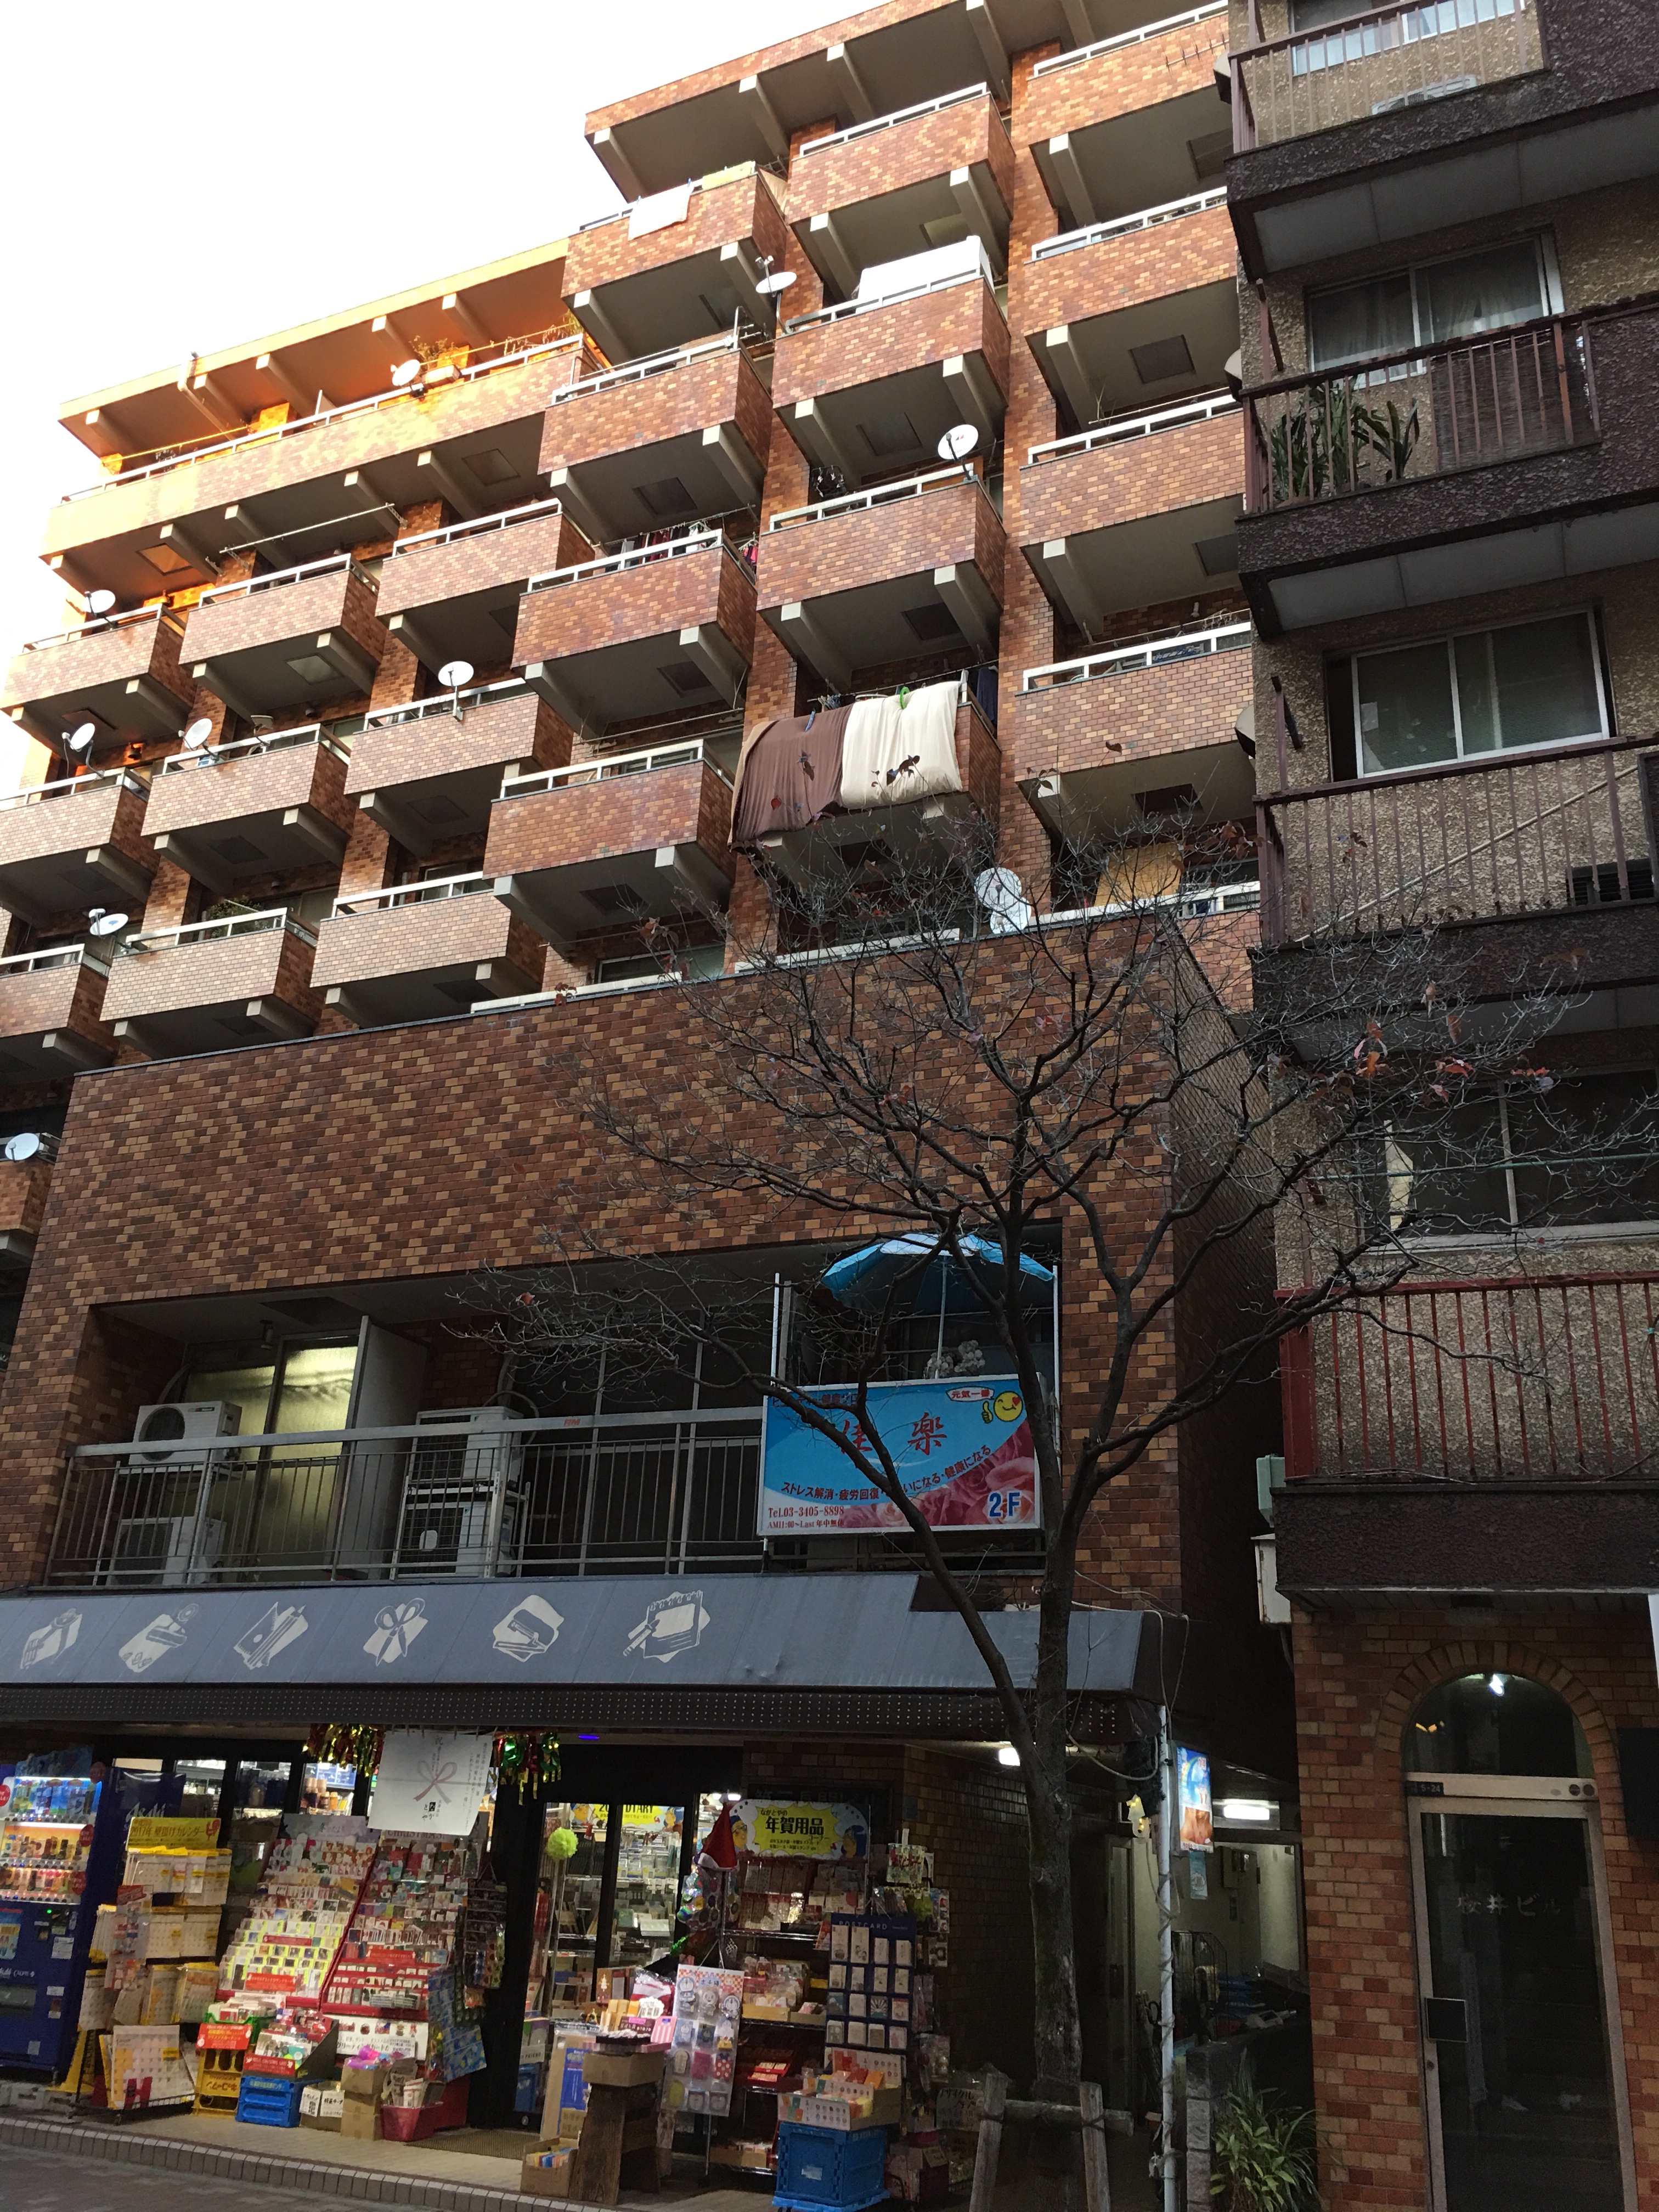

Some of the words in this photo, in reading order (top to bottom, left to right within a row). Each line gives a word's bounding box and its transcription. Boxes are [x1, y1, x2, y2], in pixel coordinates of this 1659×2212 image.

[951, 1389, 990, 1399] 元気一番
[989, 1491, 1021, 1517] 2F
[765, 1816, 825, 1836] 年賀用品
[838, 1920, 888, 1930] POSTCARD
